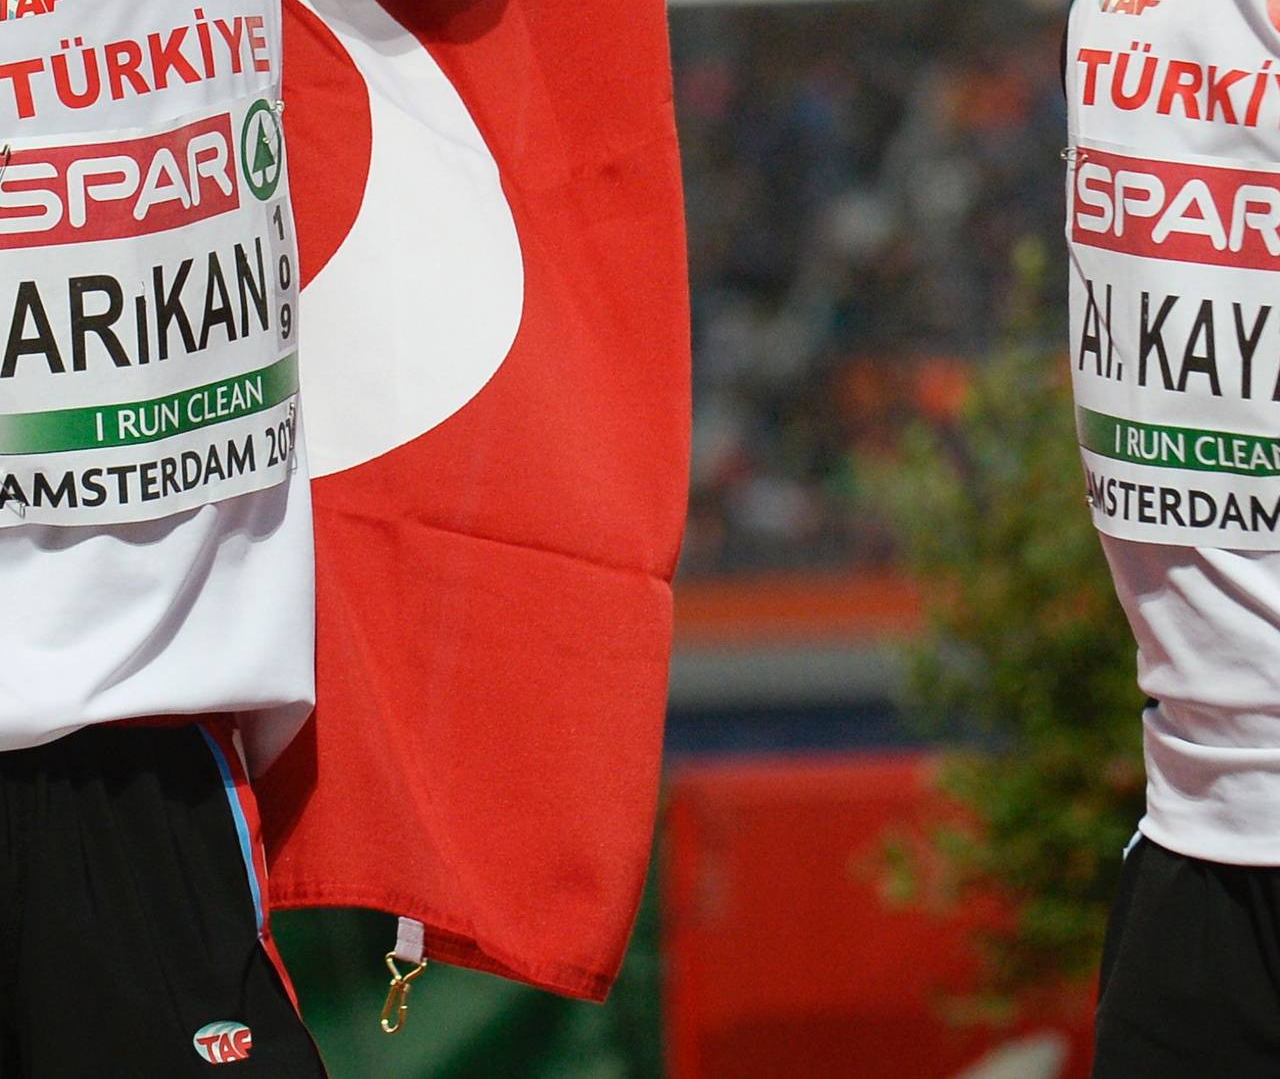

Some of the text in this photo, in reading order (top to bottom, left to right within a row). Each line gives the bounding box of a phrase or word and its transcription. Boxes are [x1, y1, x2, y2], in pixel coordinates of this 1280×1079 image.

[96, 376, 263, 441] I RUN CLEAN
[1115, 424, 1120, 453] I
[1127, 426, 1185, 463] RUN
[196, 1028, 253, 1065] TAF
